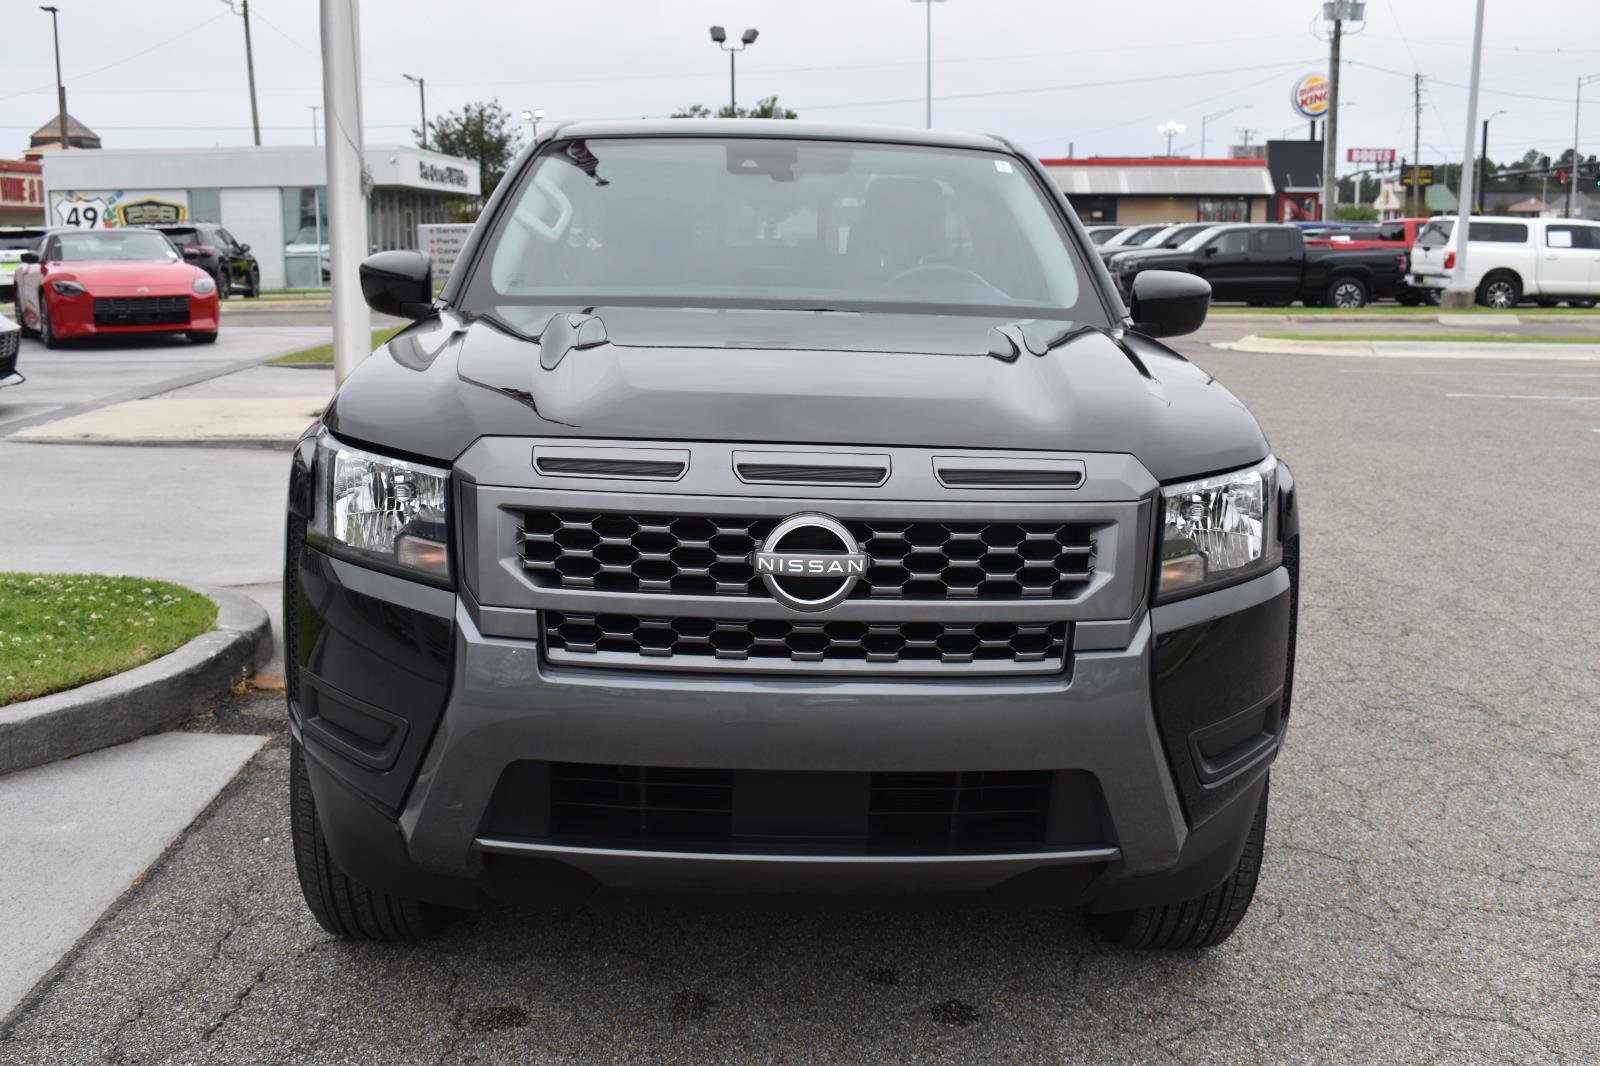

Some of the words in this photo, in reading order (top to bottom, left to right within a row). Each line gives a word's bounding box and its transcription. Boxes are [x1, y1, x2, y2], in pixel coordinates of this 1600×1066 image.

[1352, 149, 1390, 161] BOOTS
[66, 207, 98, 229] 49
[758, 557, 863, 573] NISSAN
